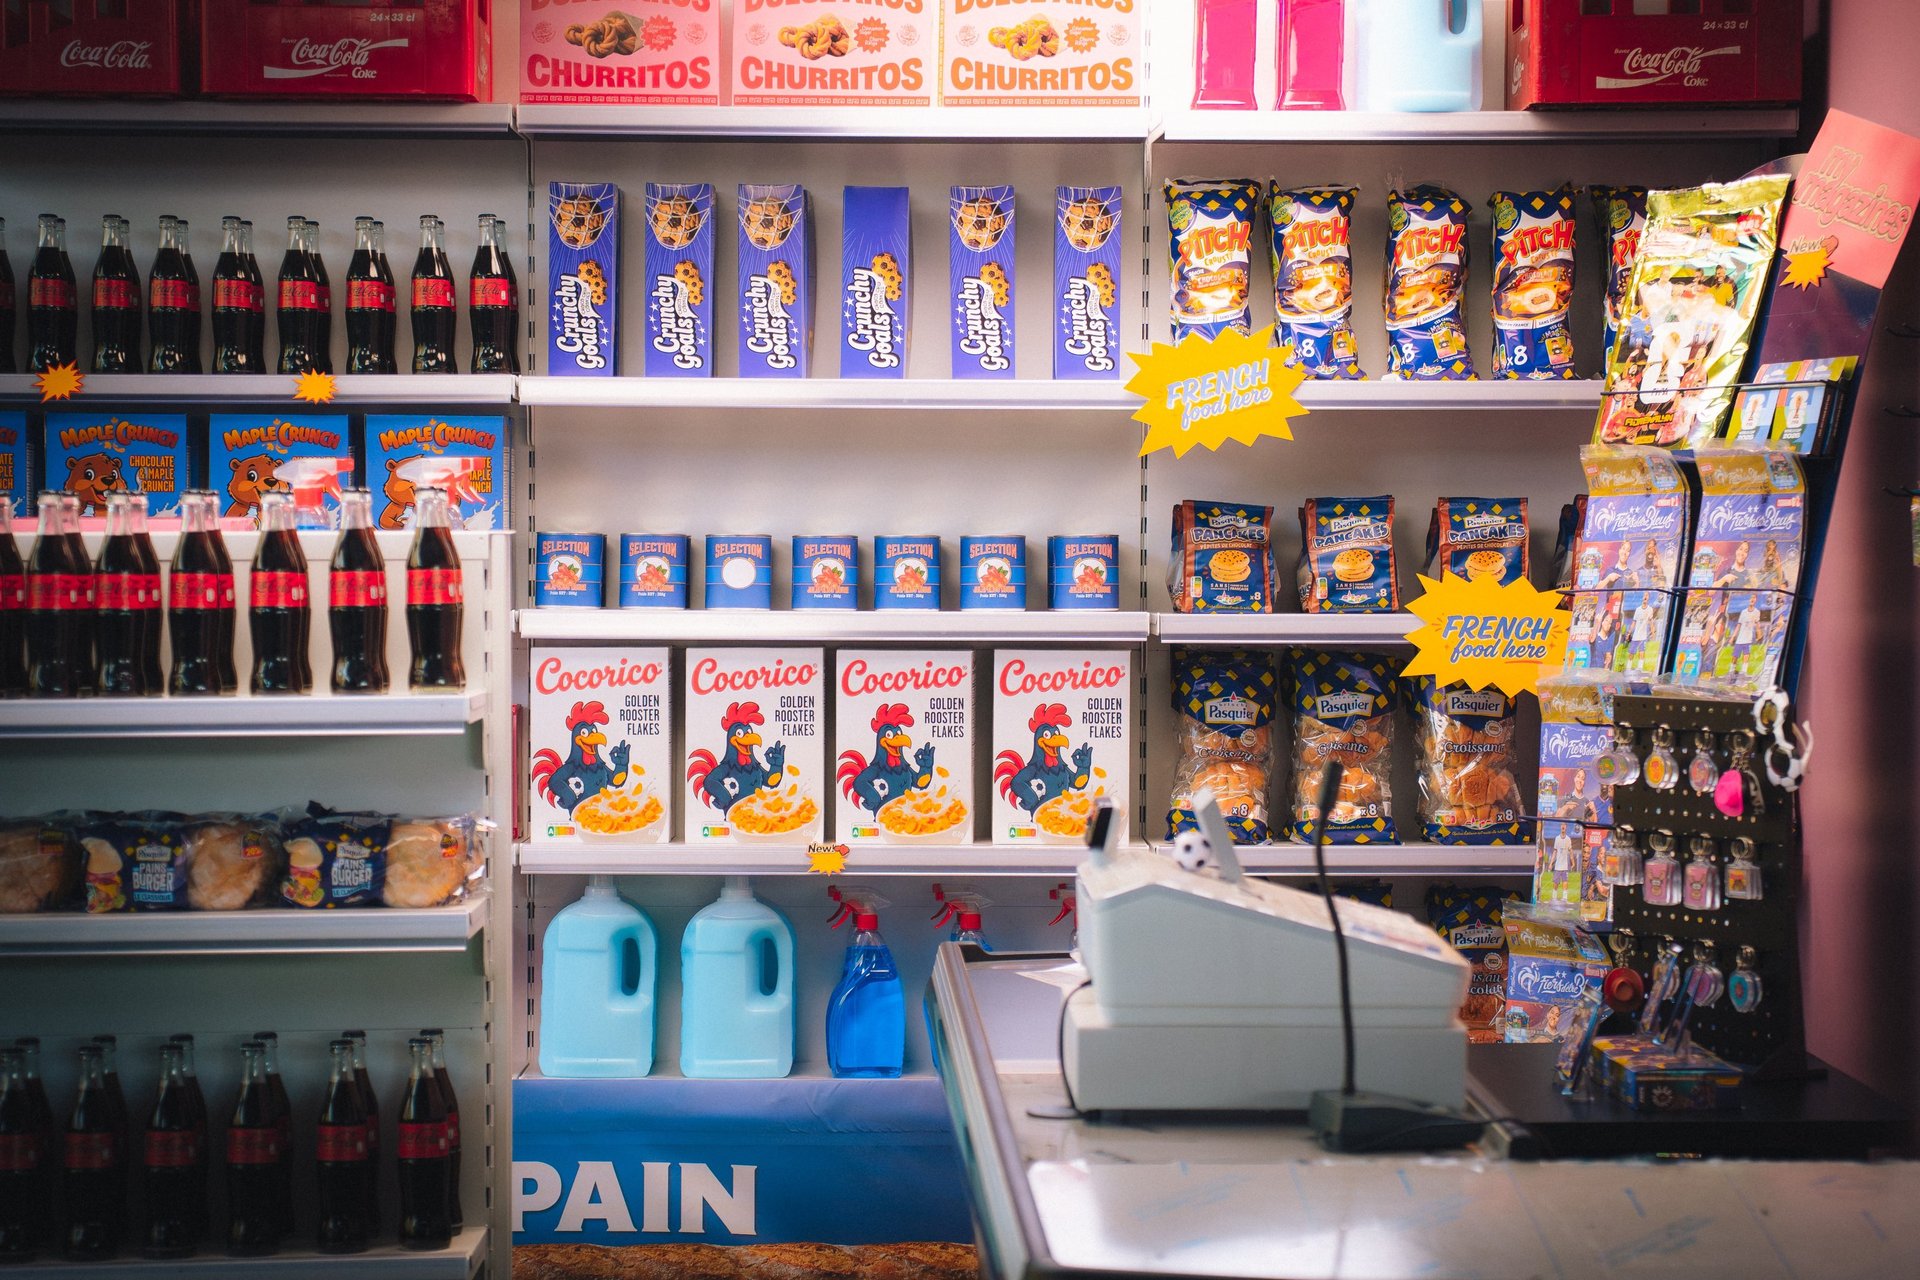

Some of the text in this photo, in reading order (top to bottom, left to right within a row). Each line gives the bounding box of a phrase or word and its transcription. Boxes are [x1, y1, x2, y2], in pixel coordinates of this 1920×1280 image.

[1738, 20, 1749, 30] cl
[60, 39, 152, 69] Coca-Cola
[291, 37, 372, 66] Coca-Cola
[1623, 46, 1703, 75] Coca-Cola
[352, 66, 378, 79] Coke
[526, 53, 711, 90] CHURRITOS
[740, 56, 923, 91] CHURRITOS
[951, 57, 1134, 91] CHURRITOS
[1683, 74, 1709, 88] Coke
[555, 274, 584, 353] Crunchy
[652, 274, 682, 353] Crunchy
[745, 274, 774, 353] Crunchy
[847, 267, 876, 350] Crunchy
[958, 276, 987, 355] Crunchy
[1063, 276, 1092, 355] Crunchy
[574, 315, 606, 369] Goals
[671, 315, 704, 369] Goals
[766, 315, 797, 369] Goals
[868, 311, 901, 368] Goals
[978, 317, 1011, 371] Goals
[1083, 317, 1116, 371] Goals
[1295, 338, 1315, 358] x8
[1400, 342, 1415, 365] x8
[1507, 345, 1528, 366] x8
[1166, 357, 1270, 410] FRENCH
[1181, 387, 1272, 431] food here
[59, 420, 180, 450] MAPLE CRUNCH
[222, 421, 341, 452] MAPLE CRUNCH
[378, 421, 496, 452] MAPLE CRUNCH
[129, 455, 175, 468] CHOCOLATE
[138, 468, 175, 480] & MAPLE
[141, 480, 175, 492] CRUNCH
[1193, 527, 1267, 541] PANCAKES
[1314, 523, 1389, 548] PANCAKES
[1448, 525, 1527, 542] PANCAKES
[542, 541, 590, 557] SELECTION
[629, 542, 677, 558] SELECTION
[714, 543, 763, 560] SELECTION
[804, 544, 851, 560] SELECTION
[886, 544, 934, 560] SELECTION
[970, 544, 1018, 560] SELECTION
[1065, 544, 1113, 560] SELECTION
[1249, 591, 1262, 601] x8
[1375, 588, 1388, 598] x8
[1442, 615, 1554, 641] FRENCH
[1450, 637, 1547, 665] food here
[535, 656, 663, 695] Cocorico
[691, 657, 818, 696] Cocorico
[841, 659, 969, 697] Cocorico
[999, 659, 1126, 697] Cocorico
[624, 695, 660, 708] GOLDEN
[780, 696, 815, 708] GOLDEN
[929, 697, 965, 710] GOLDEN
[1087, 697, 1123, 710] GOLDEN
[1320, 699, 1370, 714] Pasquier
[1451, 696, 1501, 713] Pasquier
[619, 708, 660, 722] ROOSTER
[775, 710, 815, 723] ROOSTER
[924, 711, 965, 724] ROOSTER
[1081, 711, 1123, 725] ROOSTER
[1208, 704, 1255, 721] Pasquier
[626, 722, 660, 736] FLAKES
[782, 723, 815, 737] FLAKES
[931, 725, 965, 738] FLAKES
[1089, 725, 1123, 739] FLAKES
[139, 862, 167, 873] PAINS
[338, 858, 365, 871] PAINS
[132, 870, 174, 891] BURGER
[331, 867, 373, 887] BURGER
[1454, 931, 1502, 948] Pasquier
[512, 1160, 758, 1236] PAIN
